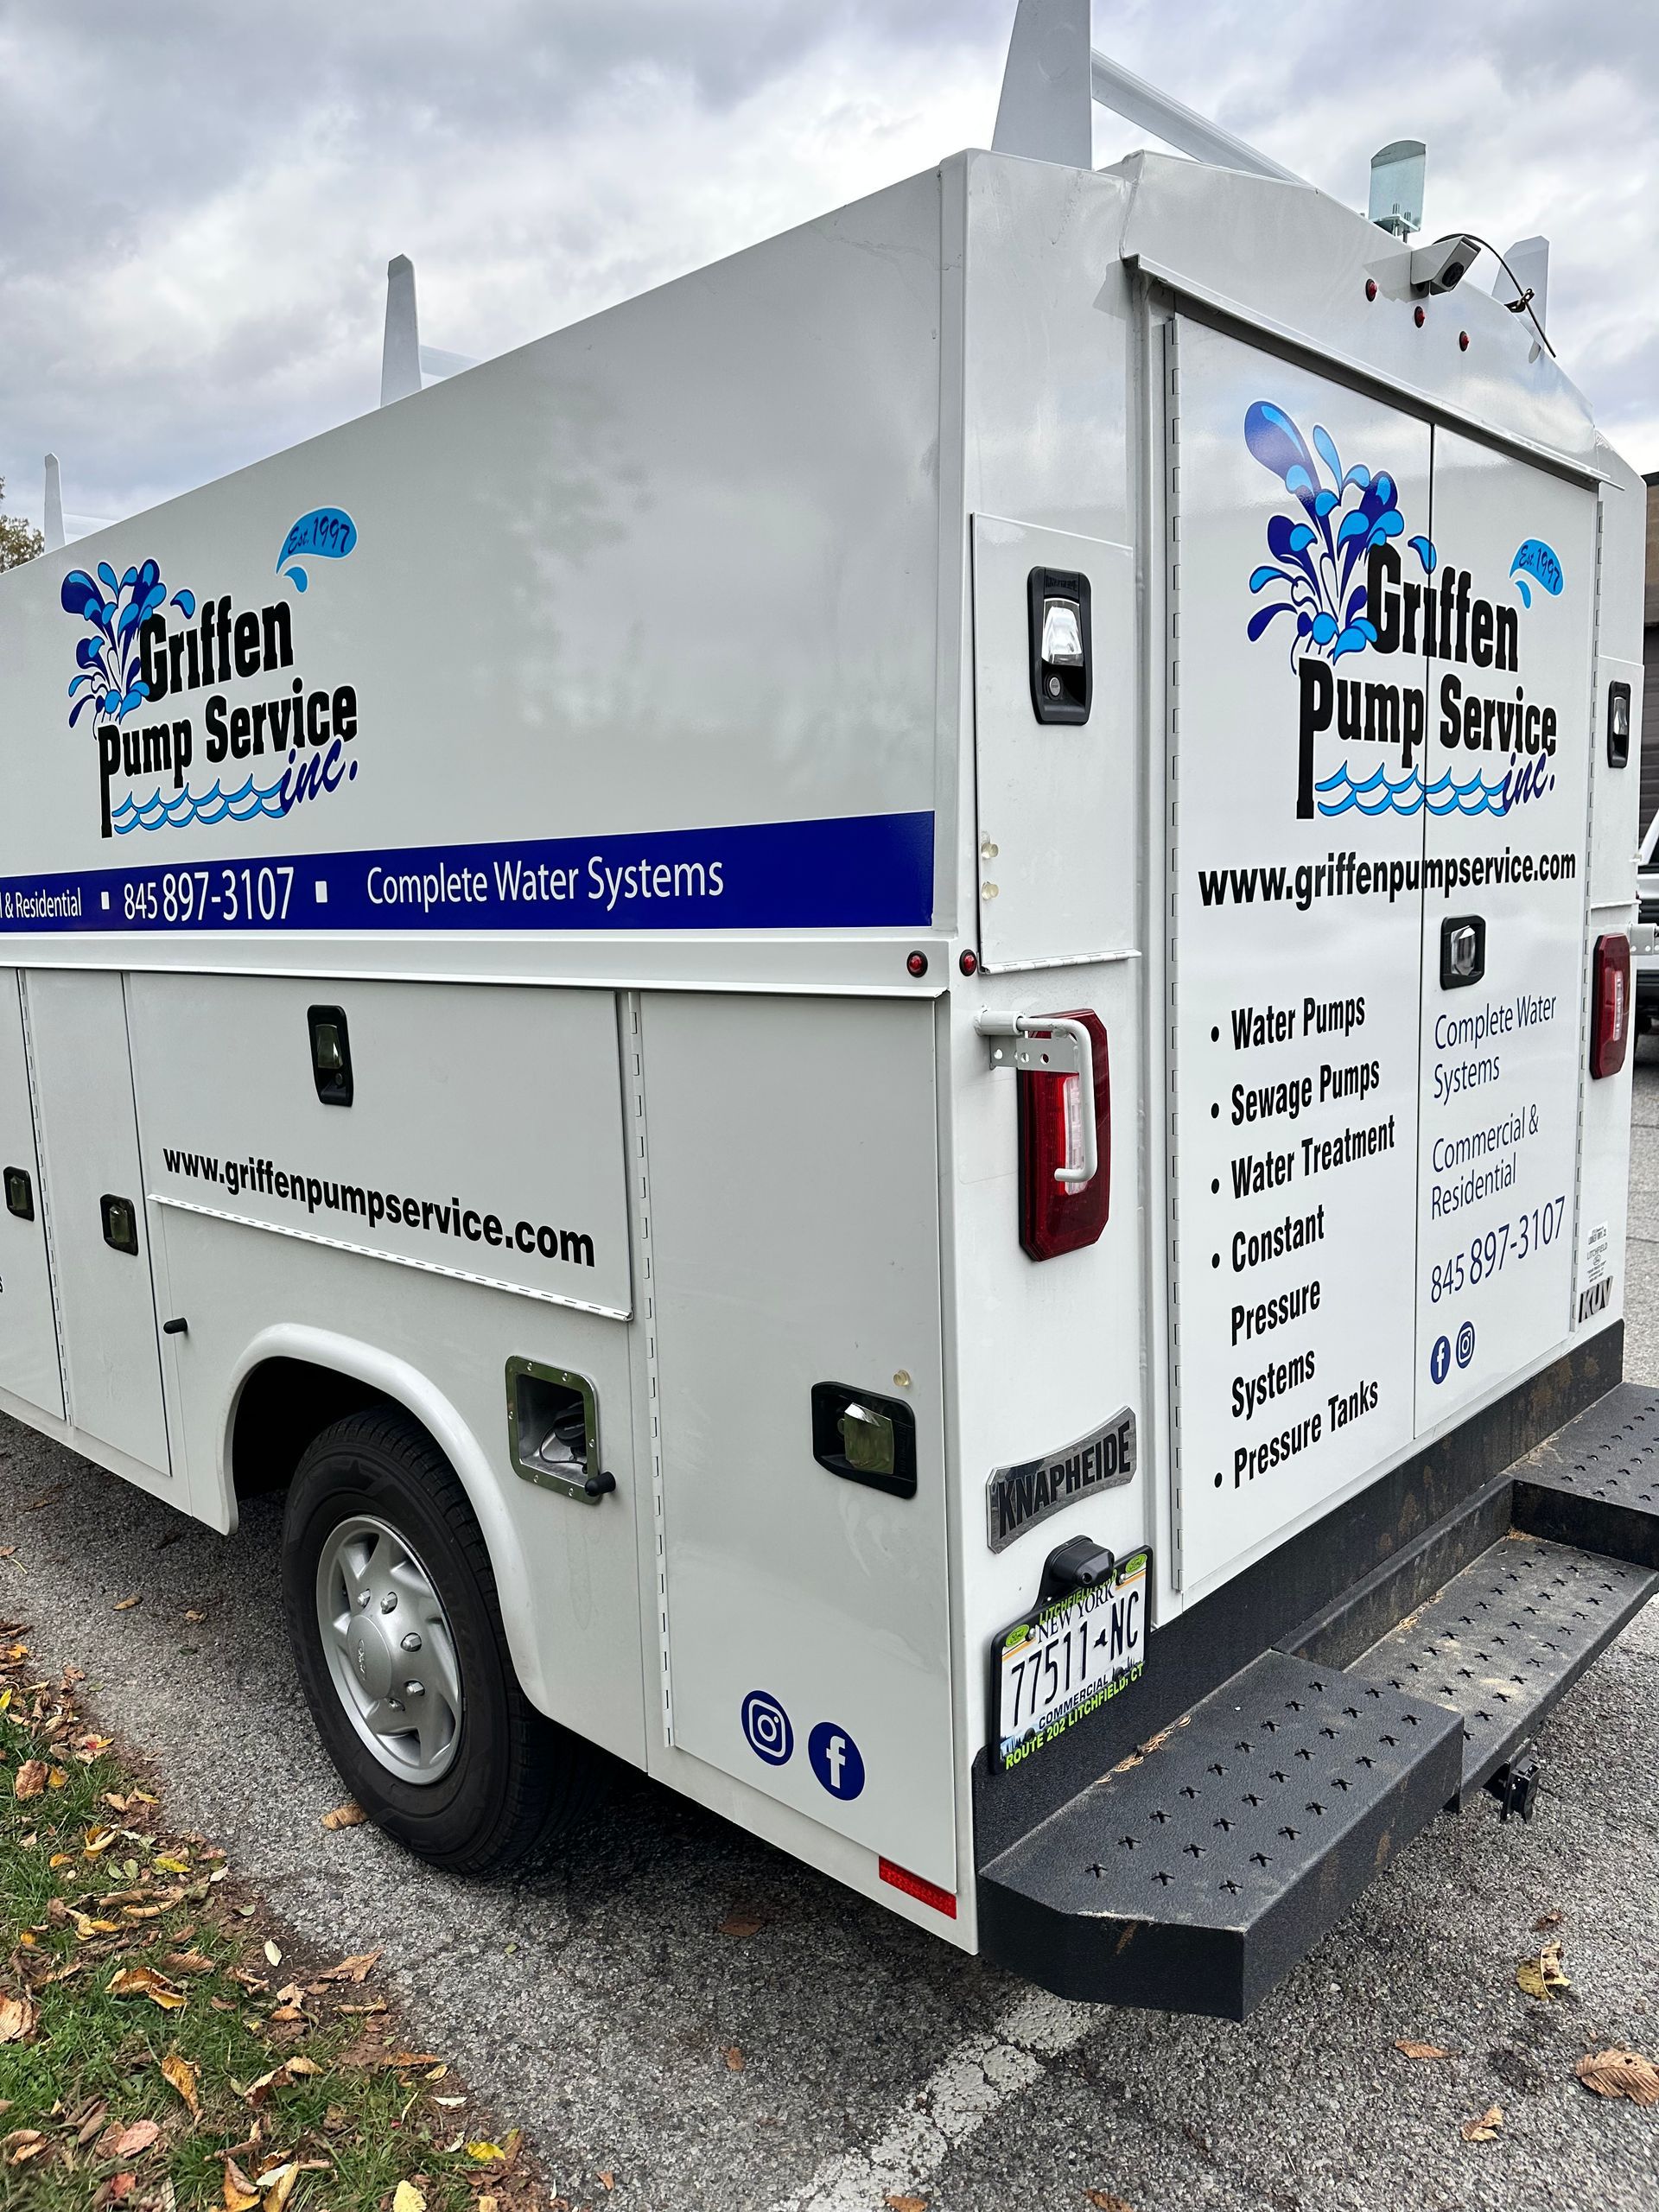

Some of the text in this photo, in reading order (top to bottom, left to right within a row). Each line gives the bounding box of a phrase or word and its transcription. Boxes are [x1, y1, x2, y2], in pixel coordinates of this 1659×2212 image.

[288, 516, 350, 554] Est. 1997
[1536, 548, 1560, 593] 1997
[1366, 543, 1519, 672] Griffen
[139, 595, 294, 702] Griffen
[97, 677, 358, 838] Pump Service
[1296, 658, 1556, 819] Pump Service
[279, 736, 359, 814] inc.
[1500, 750, 1556, 816] inc.
[4, 891, 15, 918] &
[15, 887, 82, 918] Residential
[124, 867, 294, 922] 845 897-3107
[366, 855, 724, 913] Complete Water Systems
[1198, 847, 1576, 911] www.griffenpumpservice.com
[1231, 996, 1365, 1051] Water Pumps
[1434, 995, 1557, 1050] Complete Water
[1231, 1060, 1380, 1126] Sewage Pumps
[1433, 1056, 1500, 1106] Systems
[1230, 1114, 1395, 1200] Water Treatment
[1433, 1103, 1539, 1173] Commercial &
[162, 1147, 595, 1268] www.griffenpumpservice.com
[1432, 1152, 1516, 1220] Residential
[1231, 1204, 1325, 1273] Constant
[1431, 1195, 1566, 1303] 845 897-3107
[1231, 1280, 1321, 1347] Pressure
[1579, 1275, 1614, 1323] KUV
[1231, 1350, 1315, 1421] Systems
[1234, 1380, 1378, 1489] Pressure Tanks
[997, 1420, 1131, 1539] KNAPHEIDE
[1038, 1606, 1072, 1644] NEW
[1077, 1580, 1115, 1619] YORK
[1011, 1620, 1088, 1727] 77511
[1039, 1674, 1109, 1730] COMMERCIAL
[1005, 1662, 1144, 1770] ROUTE 202 LITCHFIELD, CT
